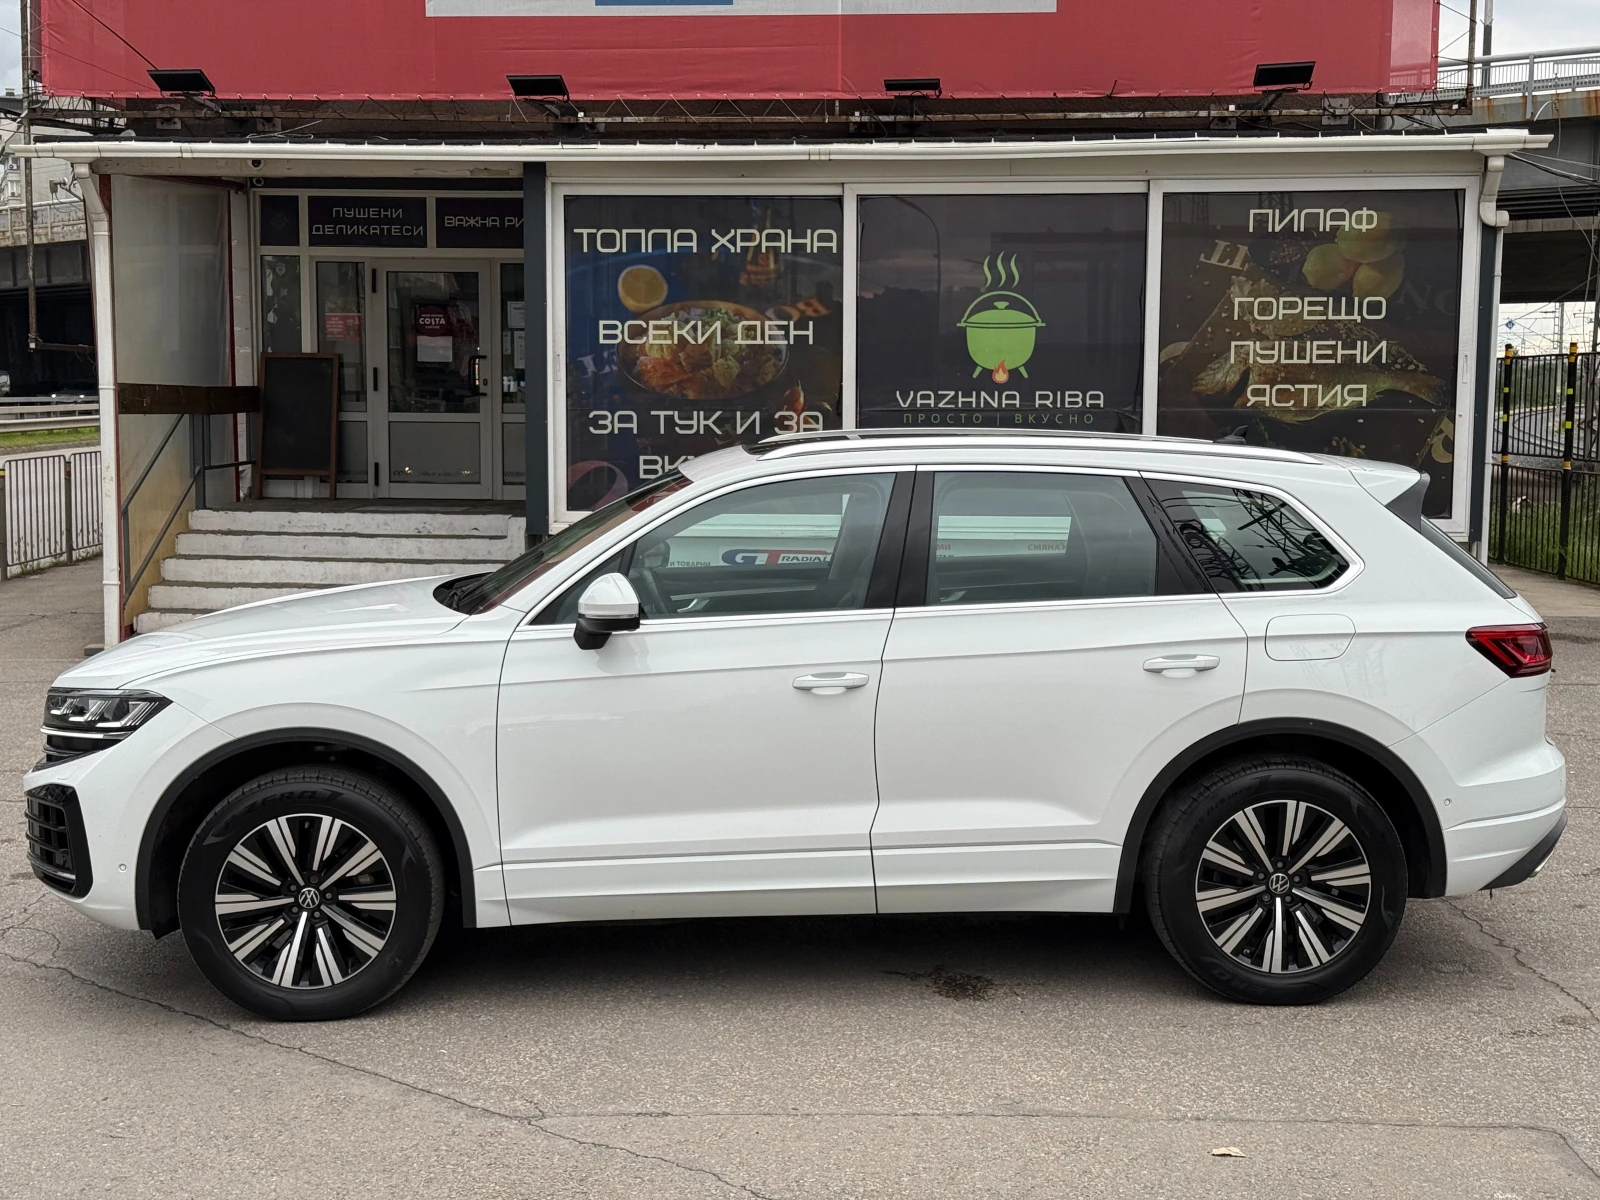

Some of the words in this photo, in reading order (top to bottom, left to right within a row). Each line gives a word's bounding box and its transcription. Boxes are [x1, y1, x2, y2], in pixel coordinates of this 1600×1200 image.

[333, 208, 402, 218] ПУШЕНИ
[445, 216, 499, 227] ВАЖНА
[1249, 207, 1377, 232] ПИЛАФ
[311, 225, 424, 236] ДЕЛИКАТЕСИ
[574, 229, 696, 252] ТОПЛА
[712, 229, 836, 253] ХРАНА
[1234, 297, 1386, 322] ГОРЕЩО
[419, 317, 446, 326] COSTA
[599, 320, 721, 345] ВСЕКИ
[734, 321, 814, 345] ДЕН
[1231, 341, 1386, 363] ПУШЕНИ
[897, 391, 1019, 407] VAZHNA
[1036, 391, 1103, 407] RIBA
[1247, 385, 1367, 406] ЯСТИЯ
[589, 411, 637, 434] ЗА
[651, 411, 722, 434] ТУК
[737, 411, 759, 434] И
[774, 411, 824, 434] ЗА
[903, 412, 983, 425] ПРОСТО
[1014, 412, 1094, 425] ВКУСНО
[639, 455, 695, 480] ВК
